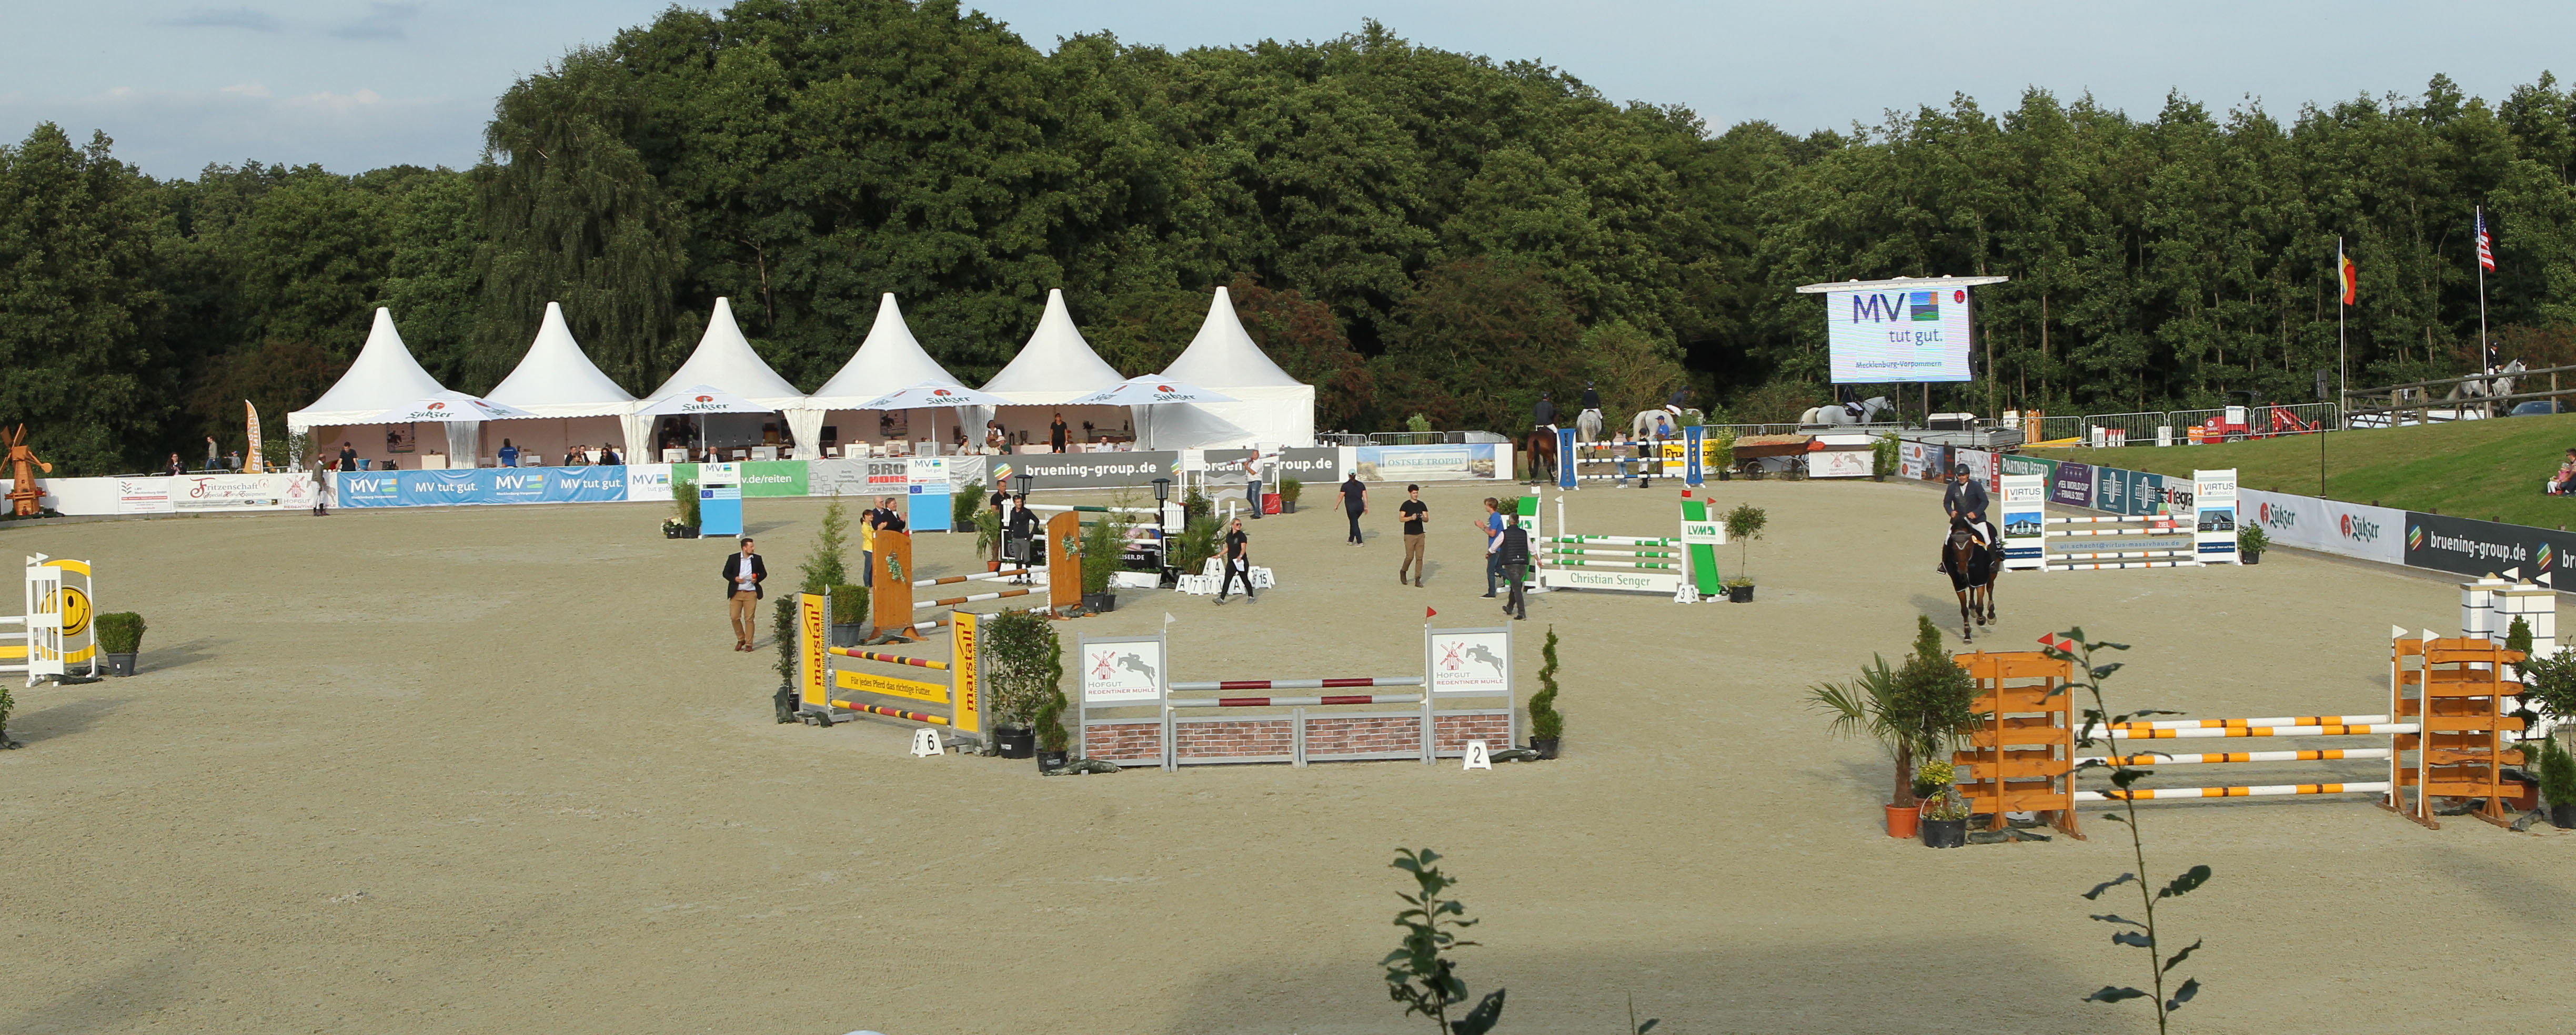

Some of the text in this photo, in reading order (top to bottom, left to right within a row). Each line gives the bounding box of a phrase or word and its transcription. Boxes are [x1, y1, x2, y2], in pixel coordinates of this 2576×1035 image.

[1853, 292, 1905, 323] MV
[1889, 328, 1943, 345] tut gut.
[868, 463, 907, 475] BRO
[1388, 458, 1423, 466] OSTSEE
[2002, 458, 2049, 478] PARTNER PFERD
[1025, 461, 1157, 478] bruening-group.de
[350, 479, 380, 493] MV
[496, 475, 525, 490] MV
[561, 479, 623, 490] MV tut gut.
[633, 474, 655, 485] MV
[2067, 481, 2081, 490] WORLD
[2081, 483, 2089, 492] CUP
[415, 482, 478, 493] MV tut gut.
[2061, 490, 2075, 500] FINALS
[2270, 503, 2296, 530] Lübzer
[1688, 525, 1706, 535] LVM
[2352, 514, 2380, 542] Lübzer
[2060, 540, 2180, 550] uli.schacht@virtus-massivhaus.de
[2430, 531, 2527, 563] bruening-group.de
[1215, 561, 1220, 573] 4
[1180, 578, 1184, 588] A
[1234, 579, 1240, 590] A
[1259, 573, 1267, 585] 15
[1571, 572, 1651, 587] Christian Senger
[1680, 587, 1695, 600] 3 3
[811, 611, 821, 687] marstall
[962, 630, 973, 712] marstall
[860, 677, 872, 687] jedes
[873, 679, 886, 689] Pferd
[886, 681, 895, 690] das
[896, 684, 914, 695] richtige
[915, 686, 931, 696] Futter.
[914, 733, 934, 750] 6 6
[1473, 746, 1482, 764] 2
